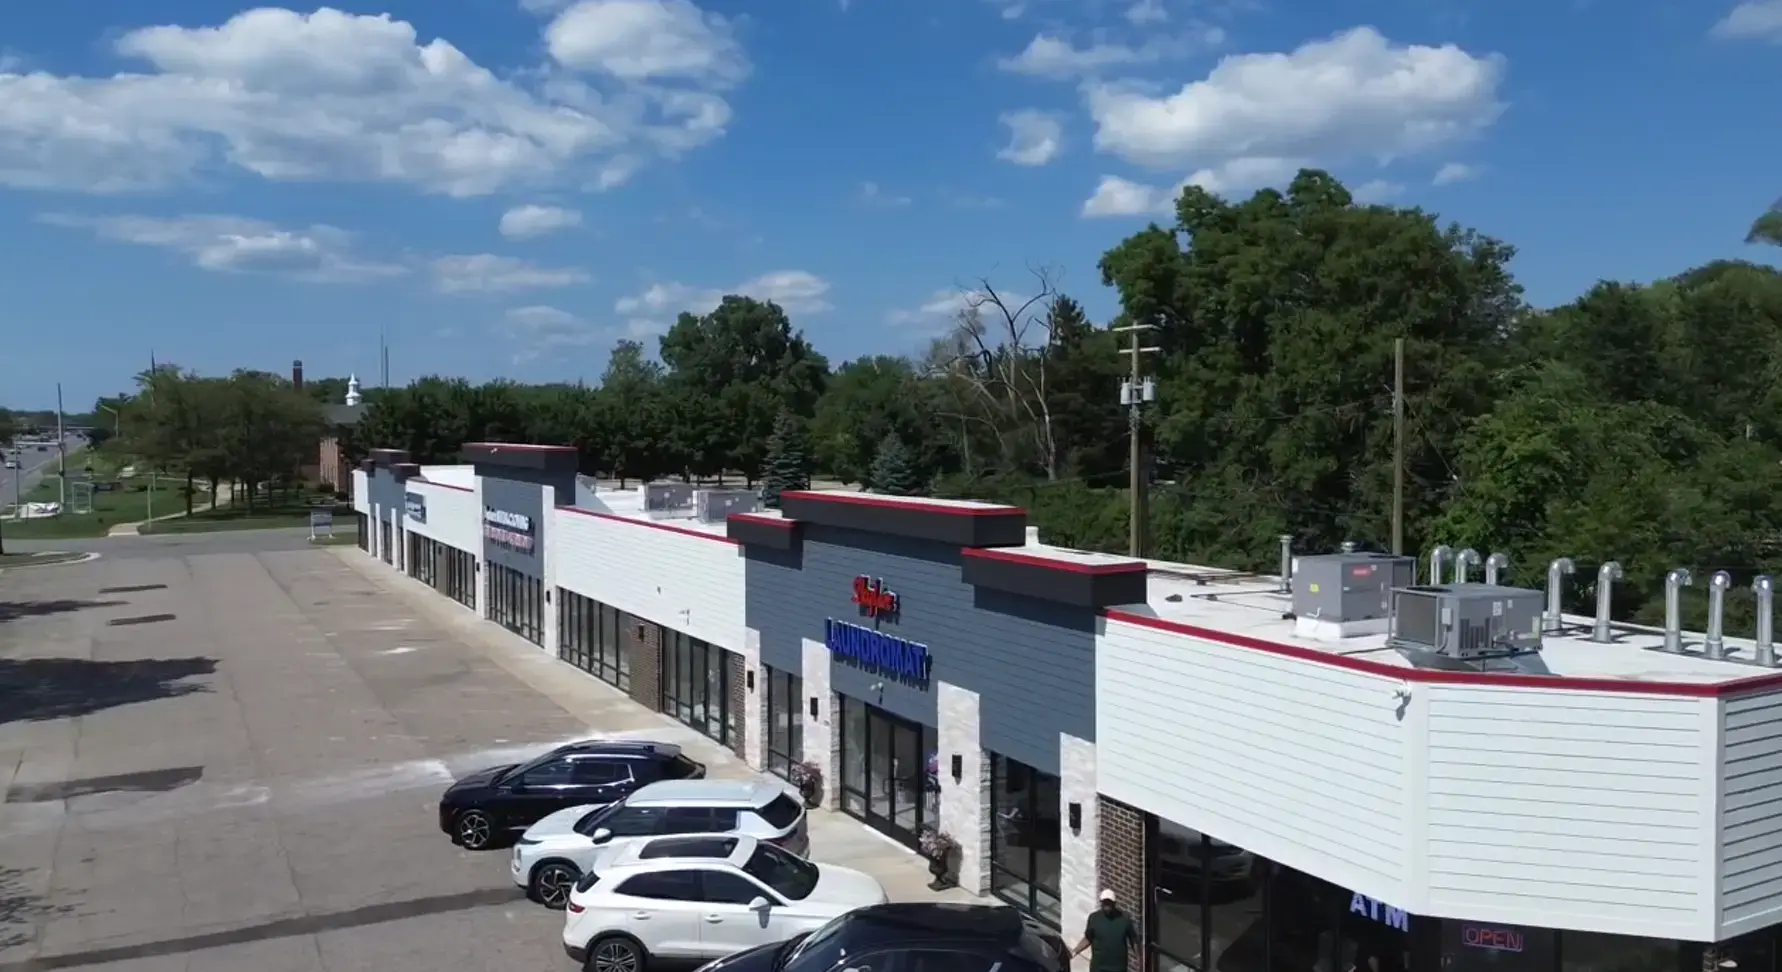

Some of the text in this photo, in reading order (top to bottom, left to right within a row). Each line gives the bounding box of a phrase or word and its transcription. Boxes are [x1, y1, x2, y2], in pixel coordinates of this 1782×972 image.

[825, 617, 928, 680] LAUNDROMAT
[1350, 892, 1409, 933] ATM
[1466, 927, 1520, 948] OPEN
